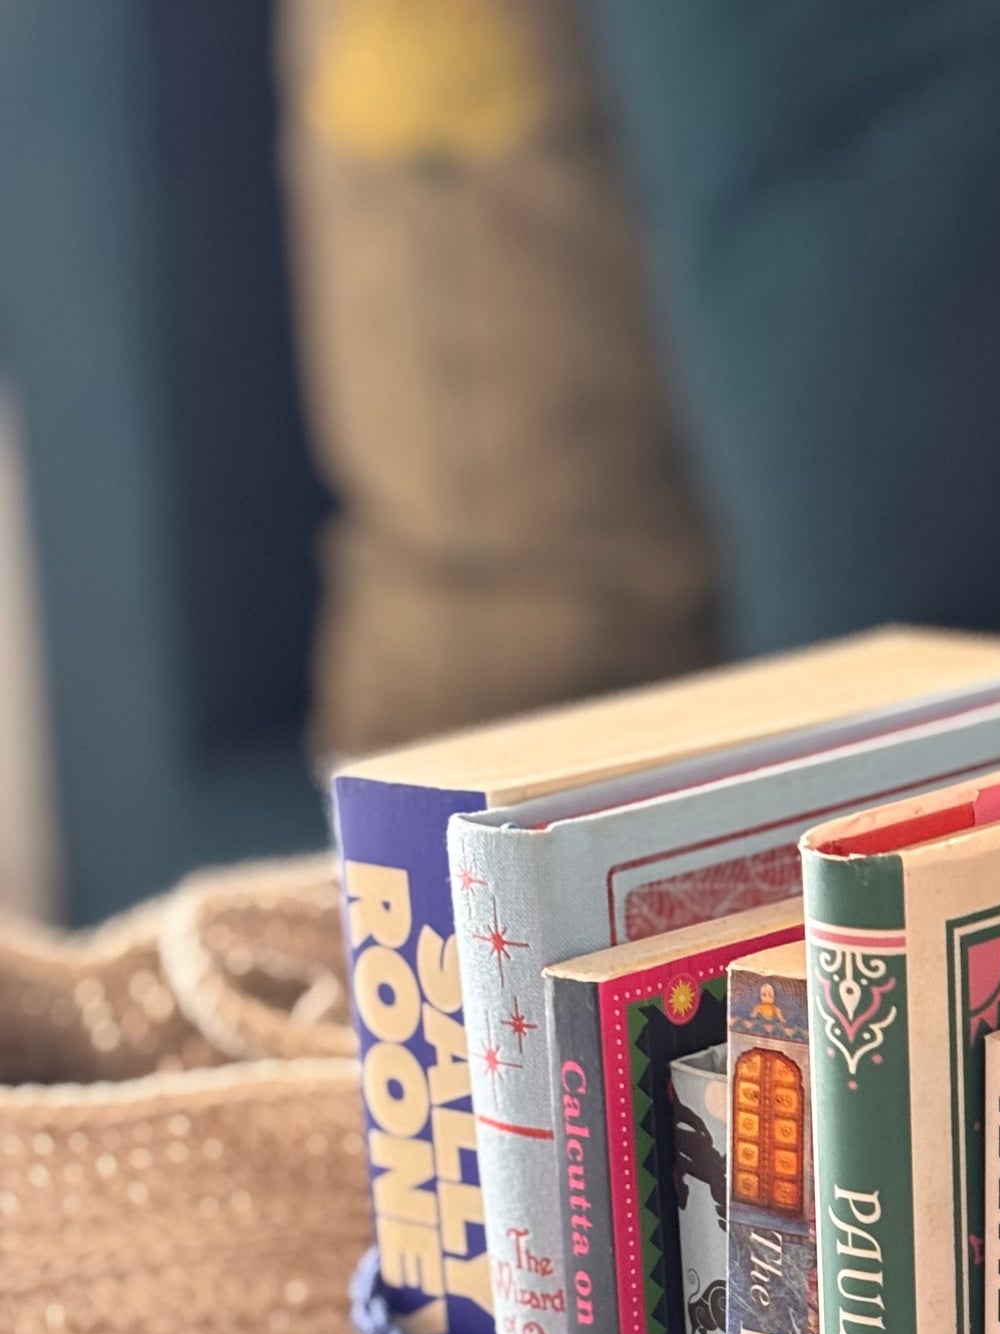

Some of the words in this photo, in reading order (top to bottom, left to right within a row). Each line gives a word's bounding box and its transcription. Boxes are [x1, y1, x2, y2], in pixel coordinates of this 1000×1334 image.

[560, 1060, 594, 1257] Calcutta
[506, 1227, 554, 1277] The
[750, 1230, 783, 1307] The
[573, 1270, 595, 1325] on
